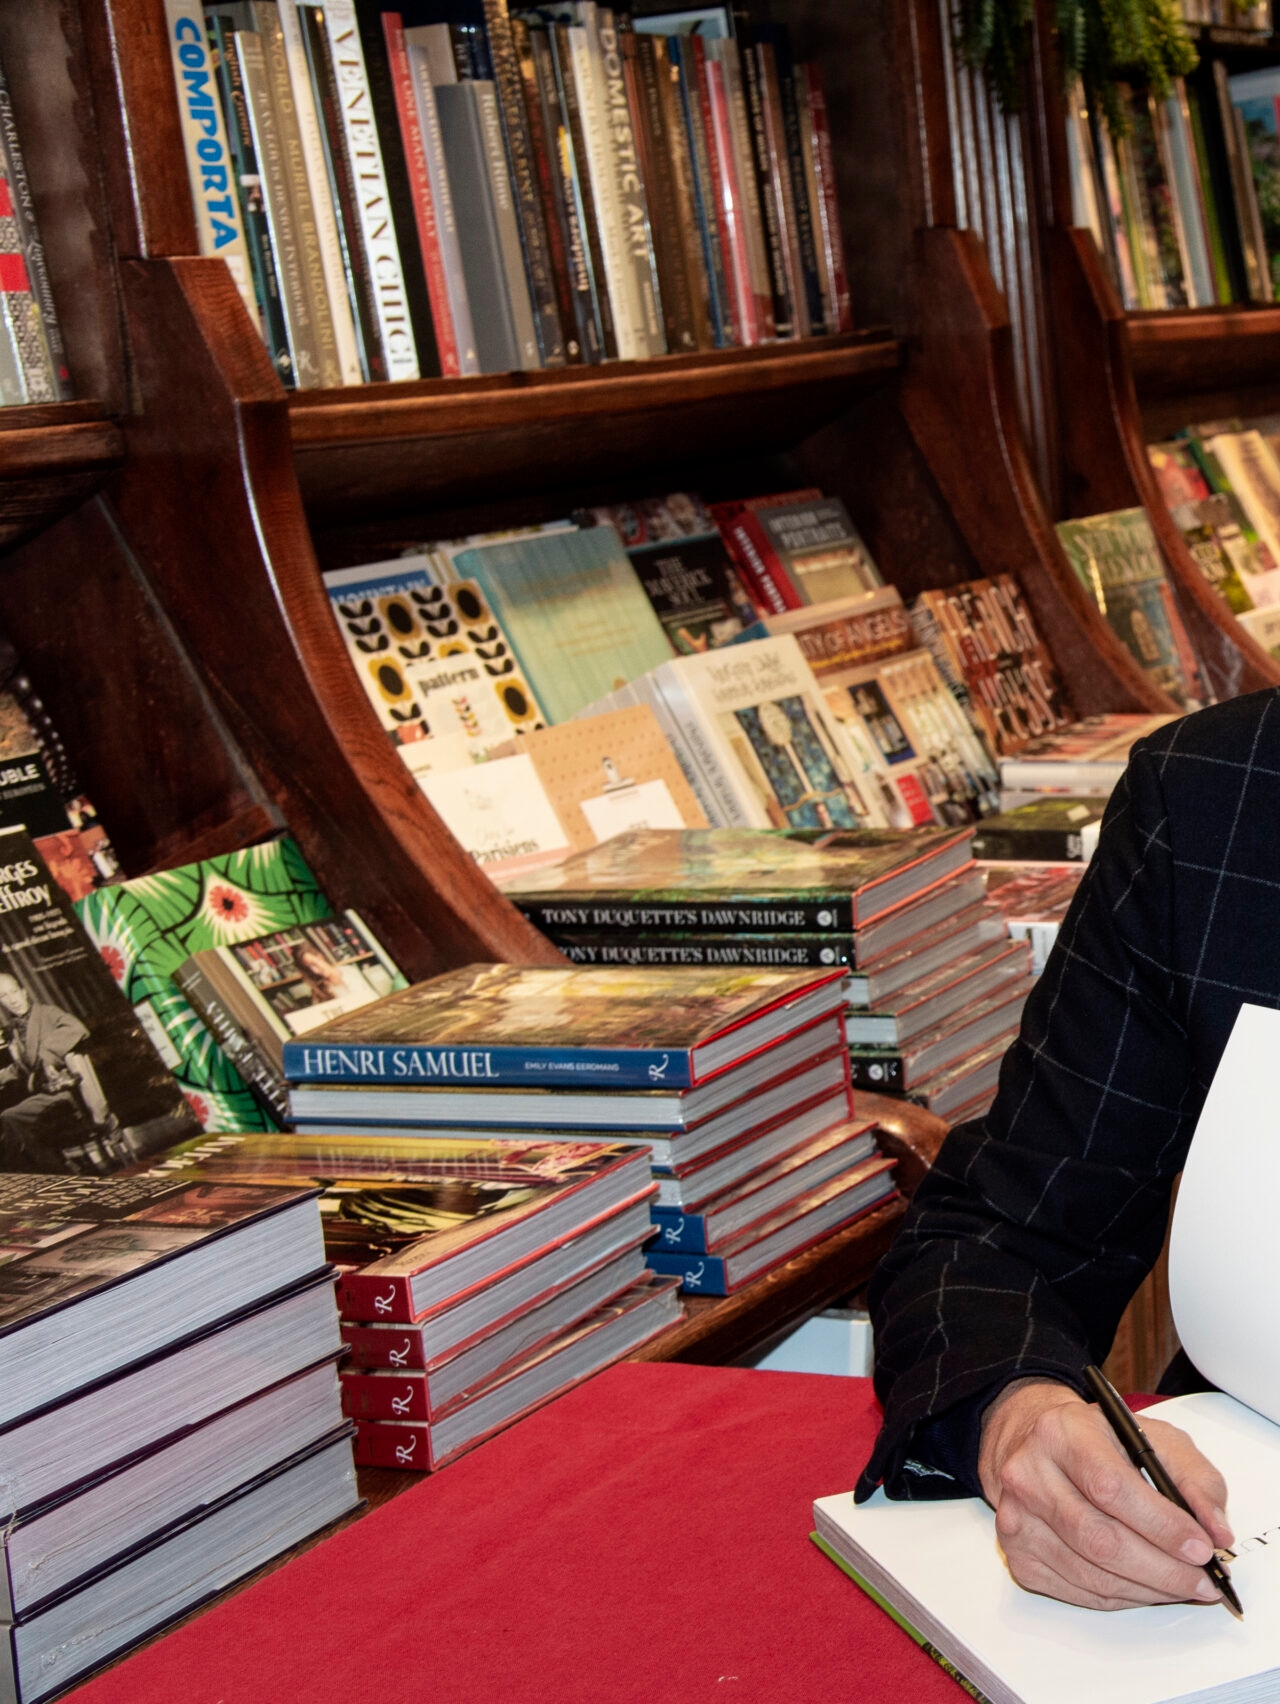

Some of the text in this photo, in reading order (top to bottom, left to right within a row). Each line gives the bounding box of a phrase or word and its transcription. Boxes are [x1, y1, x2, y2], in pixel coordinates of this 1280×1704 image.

[0, 88, 32, 207] CHARLESTON
[175, 17, 238, 249] COMPORTA
[601, 28, 649, 258] DOMESTIC ART
[334, 28, 390, 240] VENETIAN
[375, 253, 411, 355] CHIC
[302, 221, 334, 350] BRANDOLINI
[760, 574, 787, 614] PORTRA
[845, 611, 909, 649] ANGELS
[418, 667, 480, 697] pattern
[469, 837, 541, 863] Parisiens
[542, 907, 806, 926] TONY DUQUETTE'S DAWNRIDGE
[600, 946, 703, 963] DUQUETTE'S
[706, 947, 810, 965] DAWNRIDGE
[303, 1048, 387, 1076] HENRI
[392, 1049, 500, 1078] SAMUEL
[524, 1060, 547, 1071] EMILY
[547, 1061, 575, 1072] EVANS
[575, 1062, 620, 1073] EERDMANS
